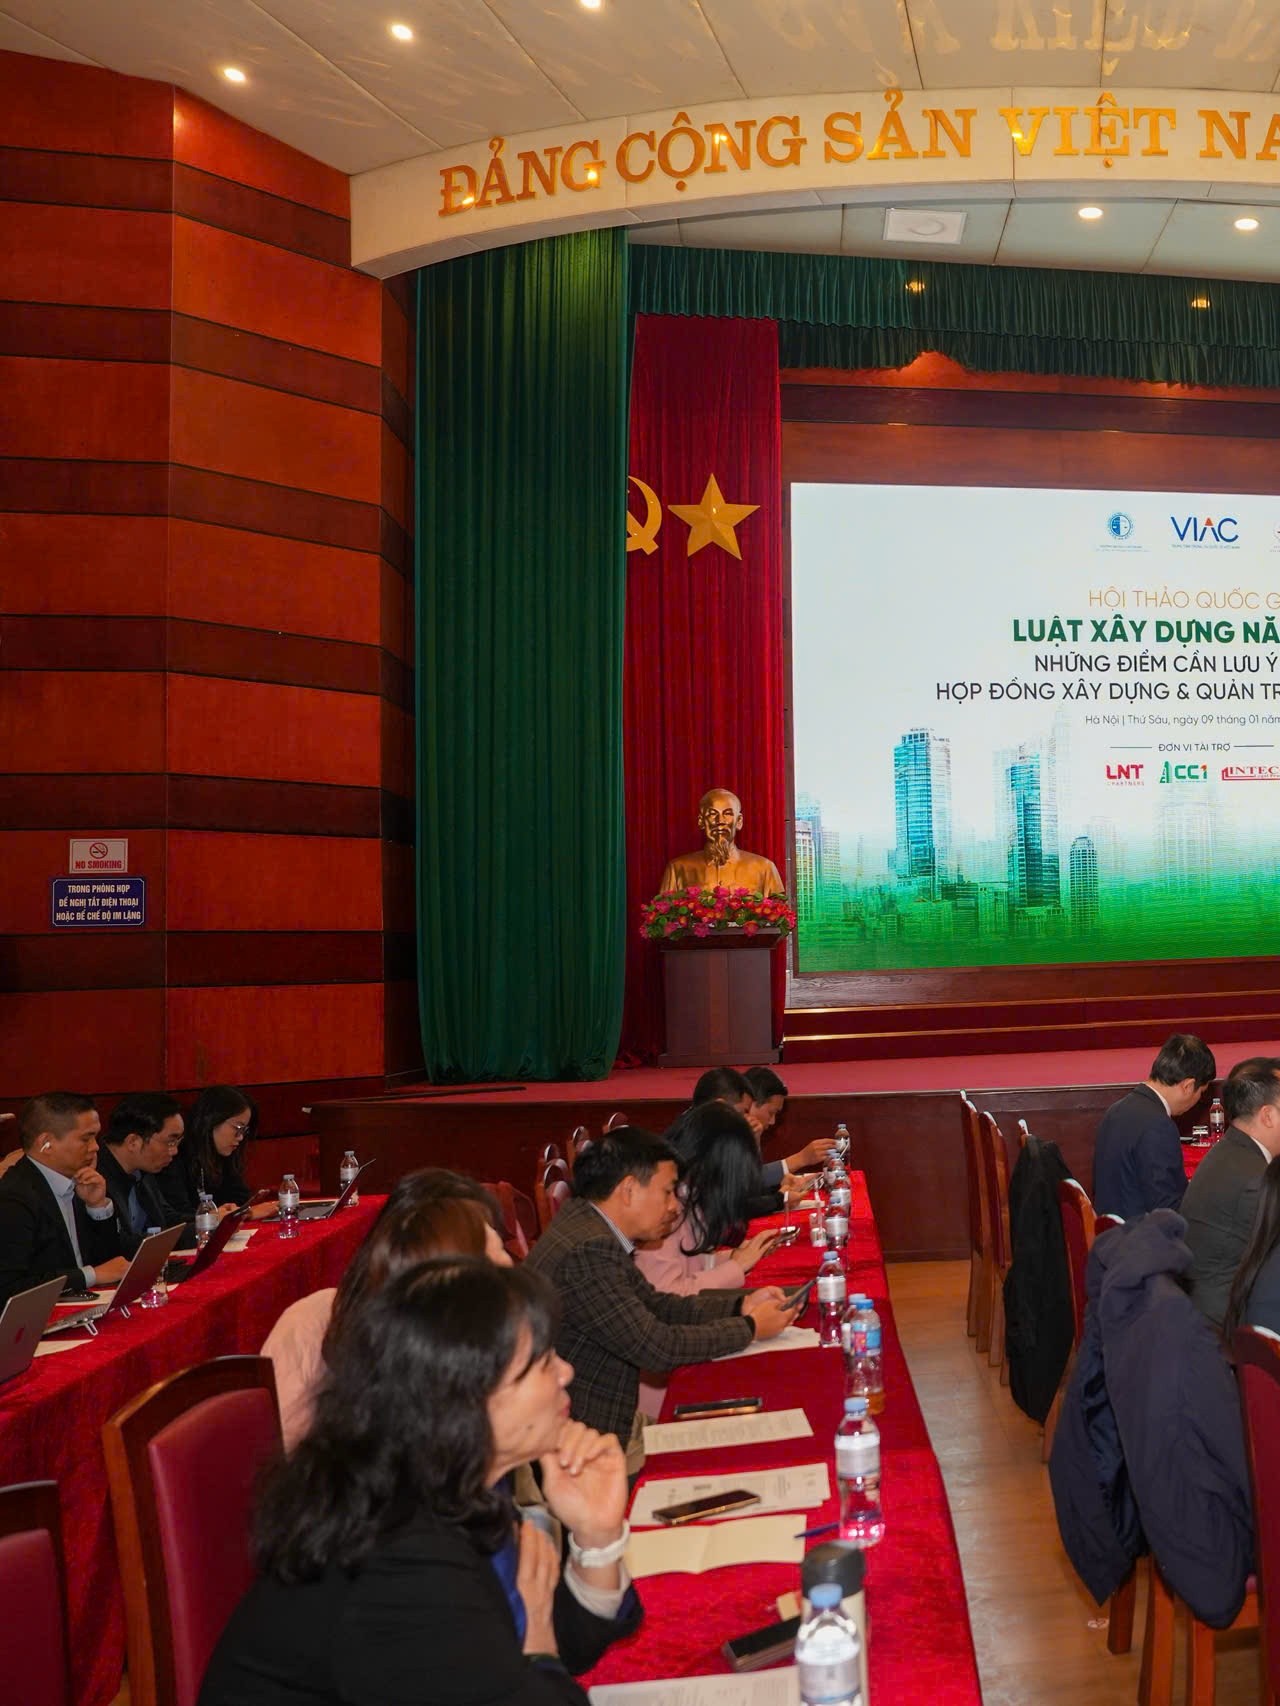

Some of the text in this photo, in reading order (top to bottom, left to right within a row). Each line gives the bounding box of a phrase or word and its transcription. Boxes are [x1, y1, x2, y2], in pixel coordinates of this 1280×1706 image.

[438, 136, 607, 217] ĐẢNG
[616, 111, 807, 191] CỘNG
[823, 89, 977, 164] SẢN
[999, 92, 1177, 168] VIỆT
[1170, 516, 1239, 543] VIAC
[1089, 590, 1126, 611] HỘI
[1133, 586, 1190, 608] THẢO
[1196, 587, 1260, 609] QUỐC
[1013, 615, 1083, 647] LUẬT
[1090, 614, 1148, 642] XÂY
[1155, 619, 1235, 648] DỰNG
[1035, 651, 1110, 672] NHỮNG
[1117, 649, 1167, 672] ĐIỂM
[1174, 649, 1216, 673] CẦN
[1223, 654, 1260, 673] LƯU
[1266, 652, 1278, 673] Ý
[937, 681, 982, 704] HỢP
[989, 677, 1055, 700] ĐỒNG
[1062, 678, 1102, 700] XÂY
[1109, 681, 1170, 704] DỰNG
[1177, 683, 1189, 700] &
[1196, 679, 1254, 701] QUẢN
[1085, 714, 1100, 725] Hà
[1103, 714, 1120, 727] Nội
[1127, 713, 1147, 725] Thứ
[1148, 713, 1170, 727] Sáu,
[1173, 715, 1199, 728] ngày
[1201, 714, 1214, 725] 09
[1216, 713, 1246, 728] tháng
[1248, 714, 1259, 725] 01
[1158, 743, 1231, 754] ĐƠN VỊ TÀI TRỢ
[1106, 764, 1144, 779] LNT
[75, 860, 122, 869] NO SMOKING
[68, 883, 130, 894] TRONG PHÒNG HỌP
[69, 898, 87, 908] NGHỊ
[101, 897, 118, 908] ĐIỆN
[119, 898, 139, 908] THOẠI
[56, 911, 75, 922] HOẶC
[87, 909, 101, 920] CHẾ
[102, 910, 111, 921] ĐỘ
[112, 911, 122, 919] IM
[123, 910, 141, 921] LẶNG
